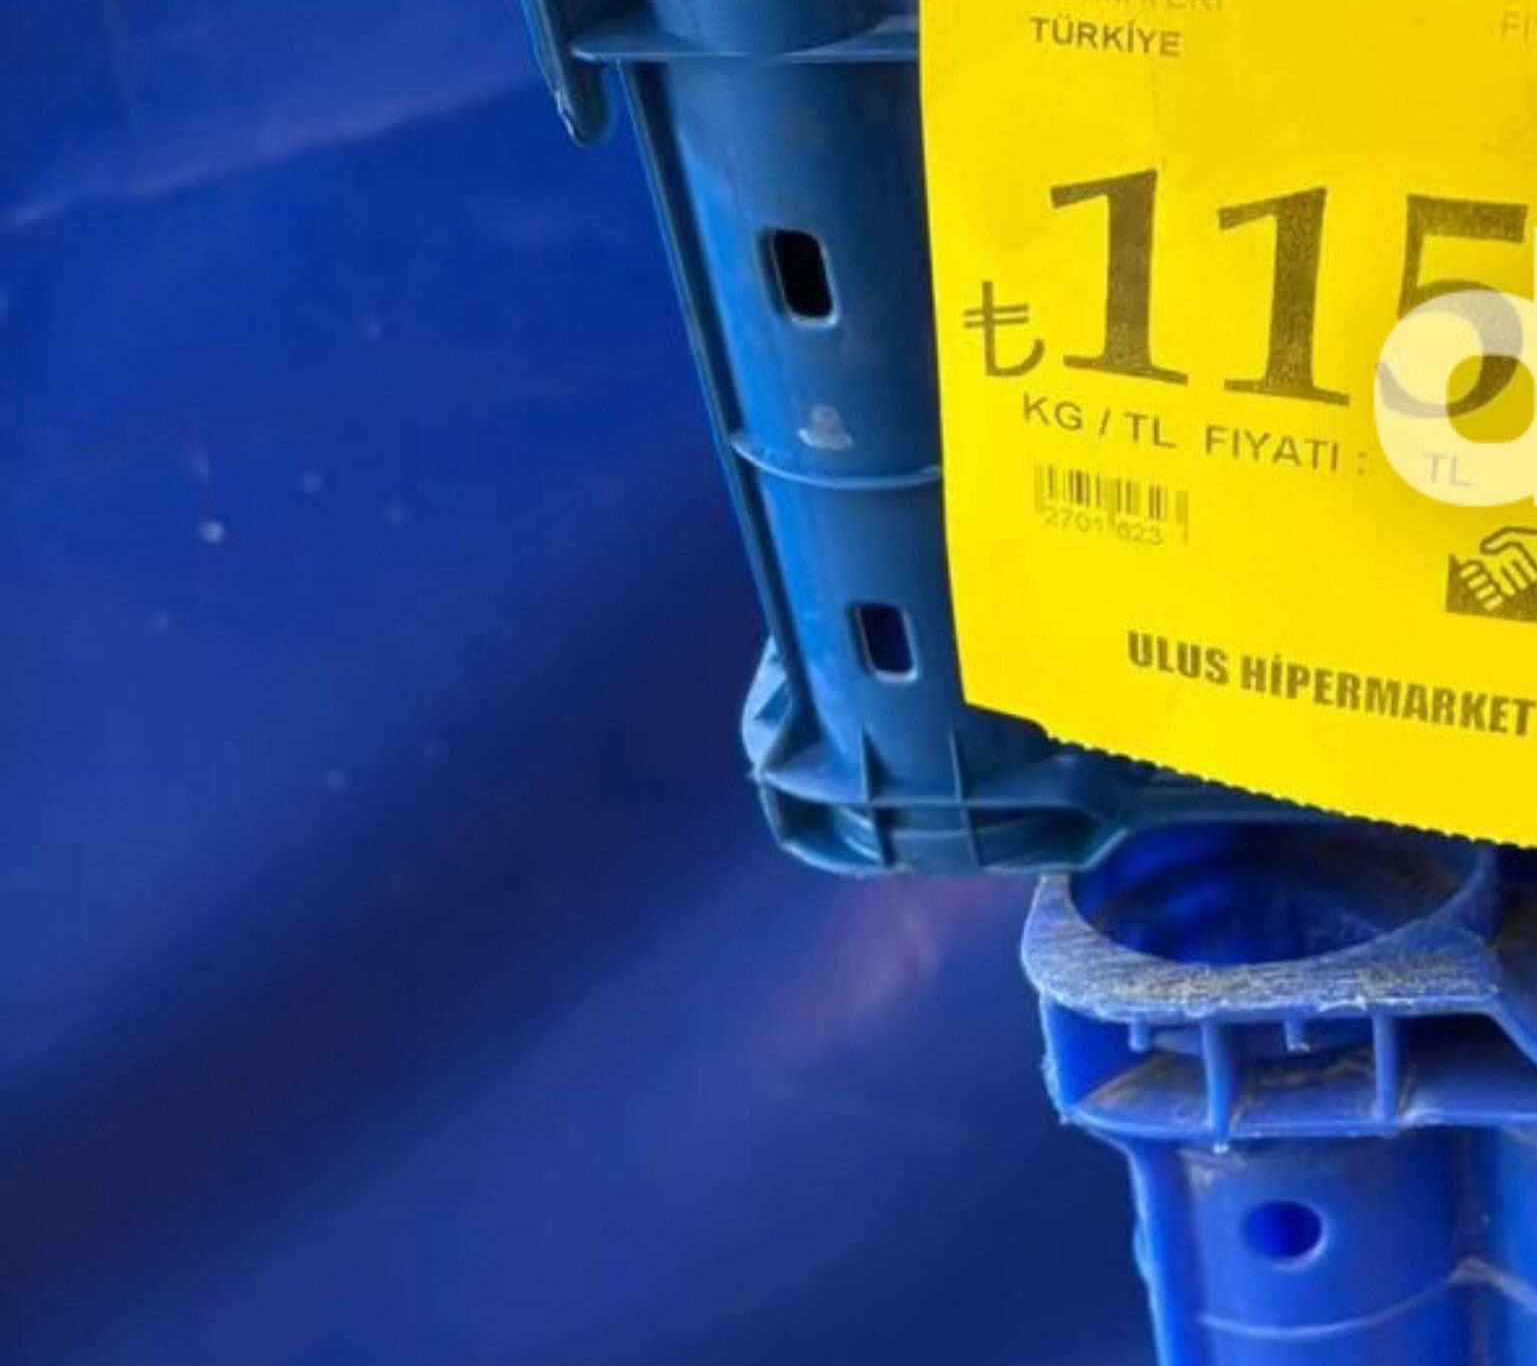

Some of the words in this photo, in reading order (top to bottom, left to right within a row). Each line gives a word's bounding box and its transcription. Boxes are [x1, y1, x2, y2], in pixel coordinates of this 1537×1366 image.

[1030, 12, 1181, 58] TÜRKİYE
[1022, 391, 1084, 432] KG
[1122, 410, 1178, 450] TL
[1421, 450, 1474, 488] TL
[1127, 630, 1229, 686] ULUS
[1240, 652, 1537, 738] HİPERMARKET
